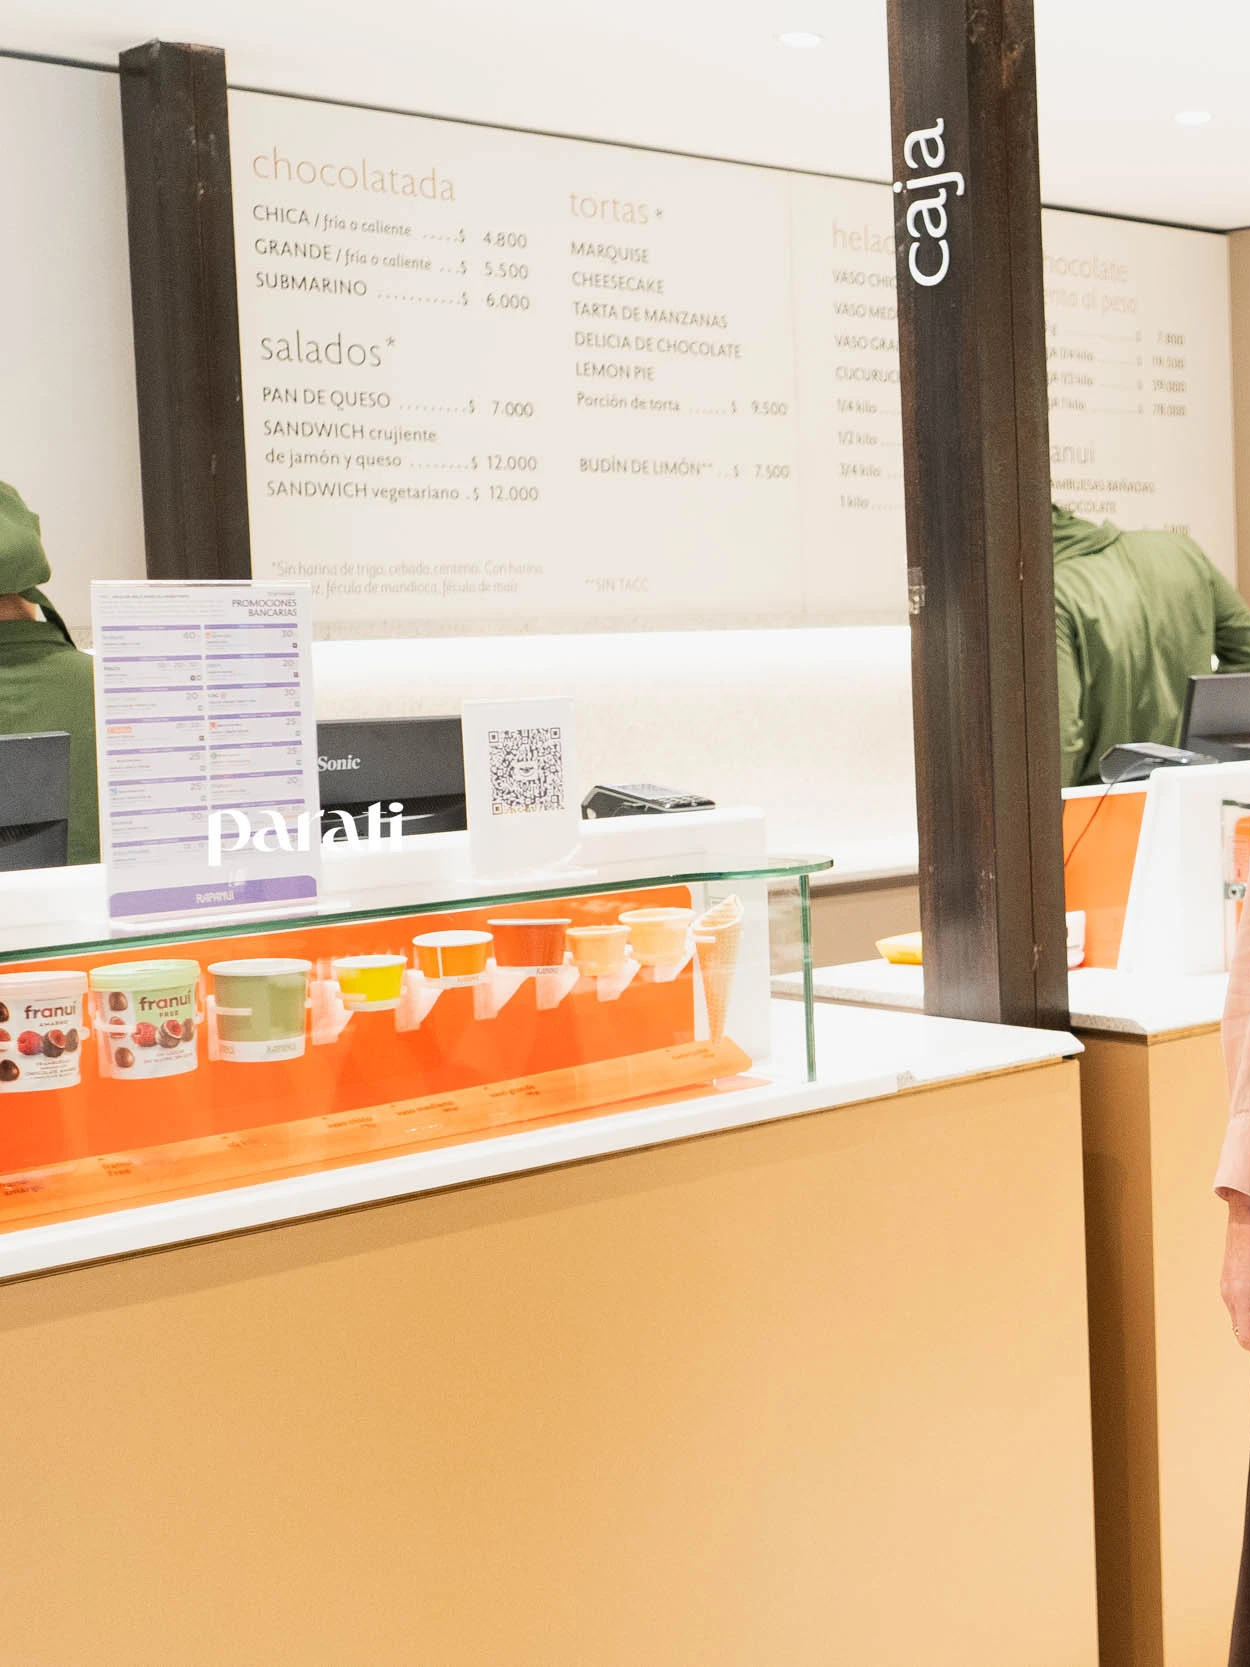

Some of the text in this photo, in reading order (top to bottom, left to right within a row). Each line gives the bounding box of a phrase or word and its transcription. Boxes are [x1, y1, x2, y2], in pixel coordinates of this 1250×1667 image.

[252, 145, 457, 202] chocolatada
[893, 118, 965, 287] caja
[252, 204, 309, 225] CHICA
[350, 220, 358, 231] o
[362, 219, 413, 237] caliente
[483, 231, 529, 248] 4.800
[254, 237, 332, 262] GRANDE
[371, 255, 379, 265] o
[382, 253, 432, 271] caliente
[484, 261, 529, 280] 5.500
[570, 240, 649, 266] MARQUISE
[832, 271, 897, 290] VASO CHIC
[1044, 254, 1128, 283] ocolate
[256, 271, 367, 297] SUBMARINO
[486, 294, 531, 310] 6.000
[572, 270, 664, 294] CHEESECAKE
[574, 300, 728, 330] TARTA DE MANZANAS
[833, 302, 897, 321] VASO MED
[574, 331, 742, 360] DELICIA DE CHOCOLATE
[835, 334, 899, 353] VASO GRA
[576, 361, 655, 382] LEMON PIE
[835, 366, 900, 385] CUCURUC
[263, 386, 297, 404] PAN
[303, 388, 326, 405] DE
[330, 390, 391, 411] QUESO
[492, 401, 534, 418] 7.000
[577, 391, 627, 409] Porción
[631, 394, 647, 410] de
[650, 396, 680, 413] torta
[751, 400, 787, 416] 9.500
[264, 419, 437, 445] SANDWICH crujiente
[265, 450, 285, 465] de
[287, 450, 340, 468] jamón
[344, 455, 351, 470] y
[355, 456, 402, 474] queso
[487, 455, 538, 471] 12.000
[579, 455, 627, 474] BUDÍN
[631, 458, 648, 475] DE
[754, 464, 790, 479] 7.500
[266, 480, 368, 498] SANDWICH
[371, 485, 460, 504] vegetariano
[489, 485, 539, 501] 12.000
[232, 599, 297, 608] PROMOCIONES
[248, 608, 297, 617] BANCARIAS
[316, 754, 361, 772] Sonic
